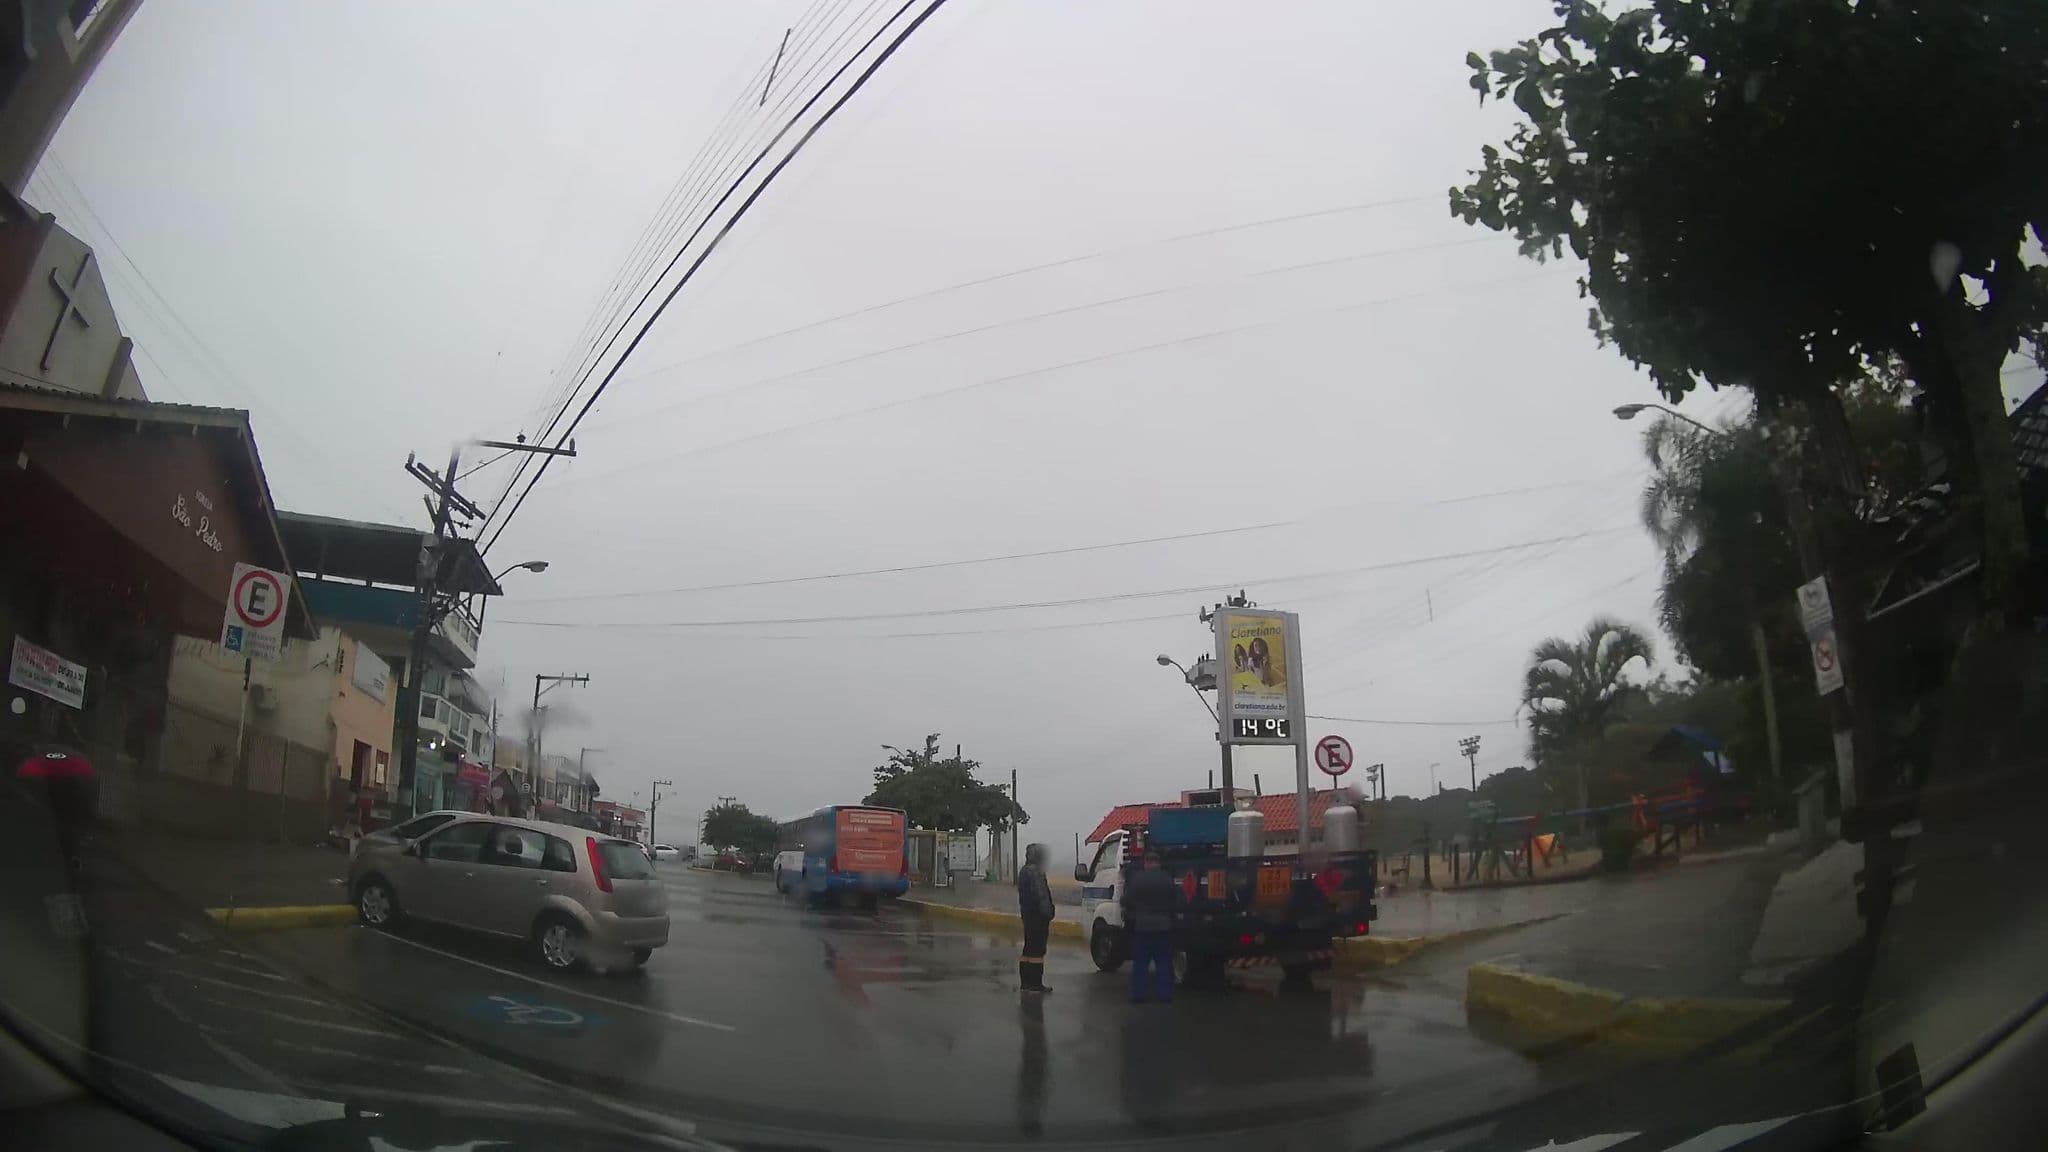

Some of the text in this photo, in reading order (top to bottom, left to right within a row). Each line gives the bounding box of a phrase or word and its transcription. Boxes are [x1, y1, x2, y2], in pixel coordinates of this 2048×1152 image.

[172, 493, 223, 552] São Pedro
[247, 581, 270, 616] E
[1241, 719, 1258, 736] 14
[1327, 743, 1344, 768] E
